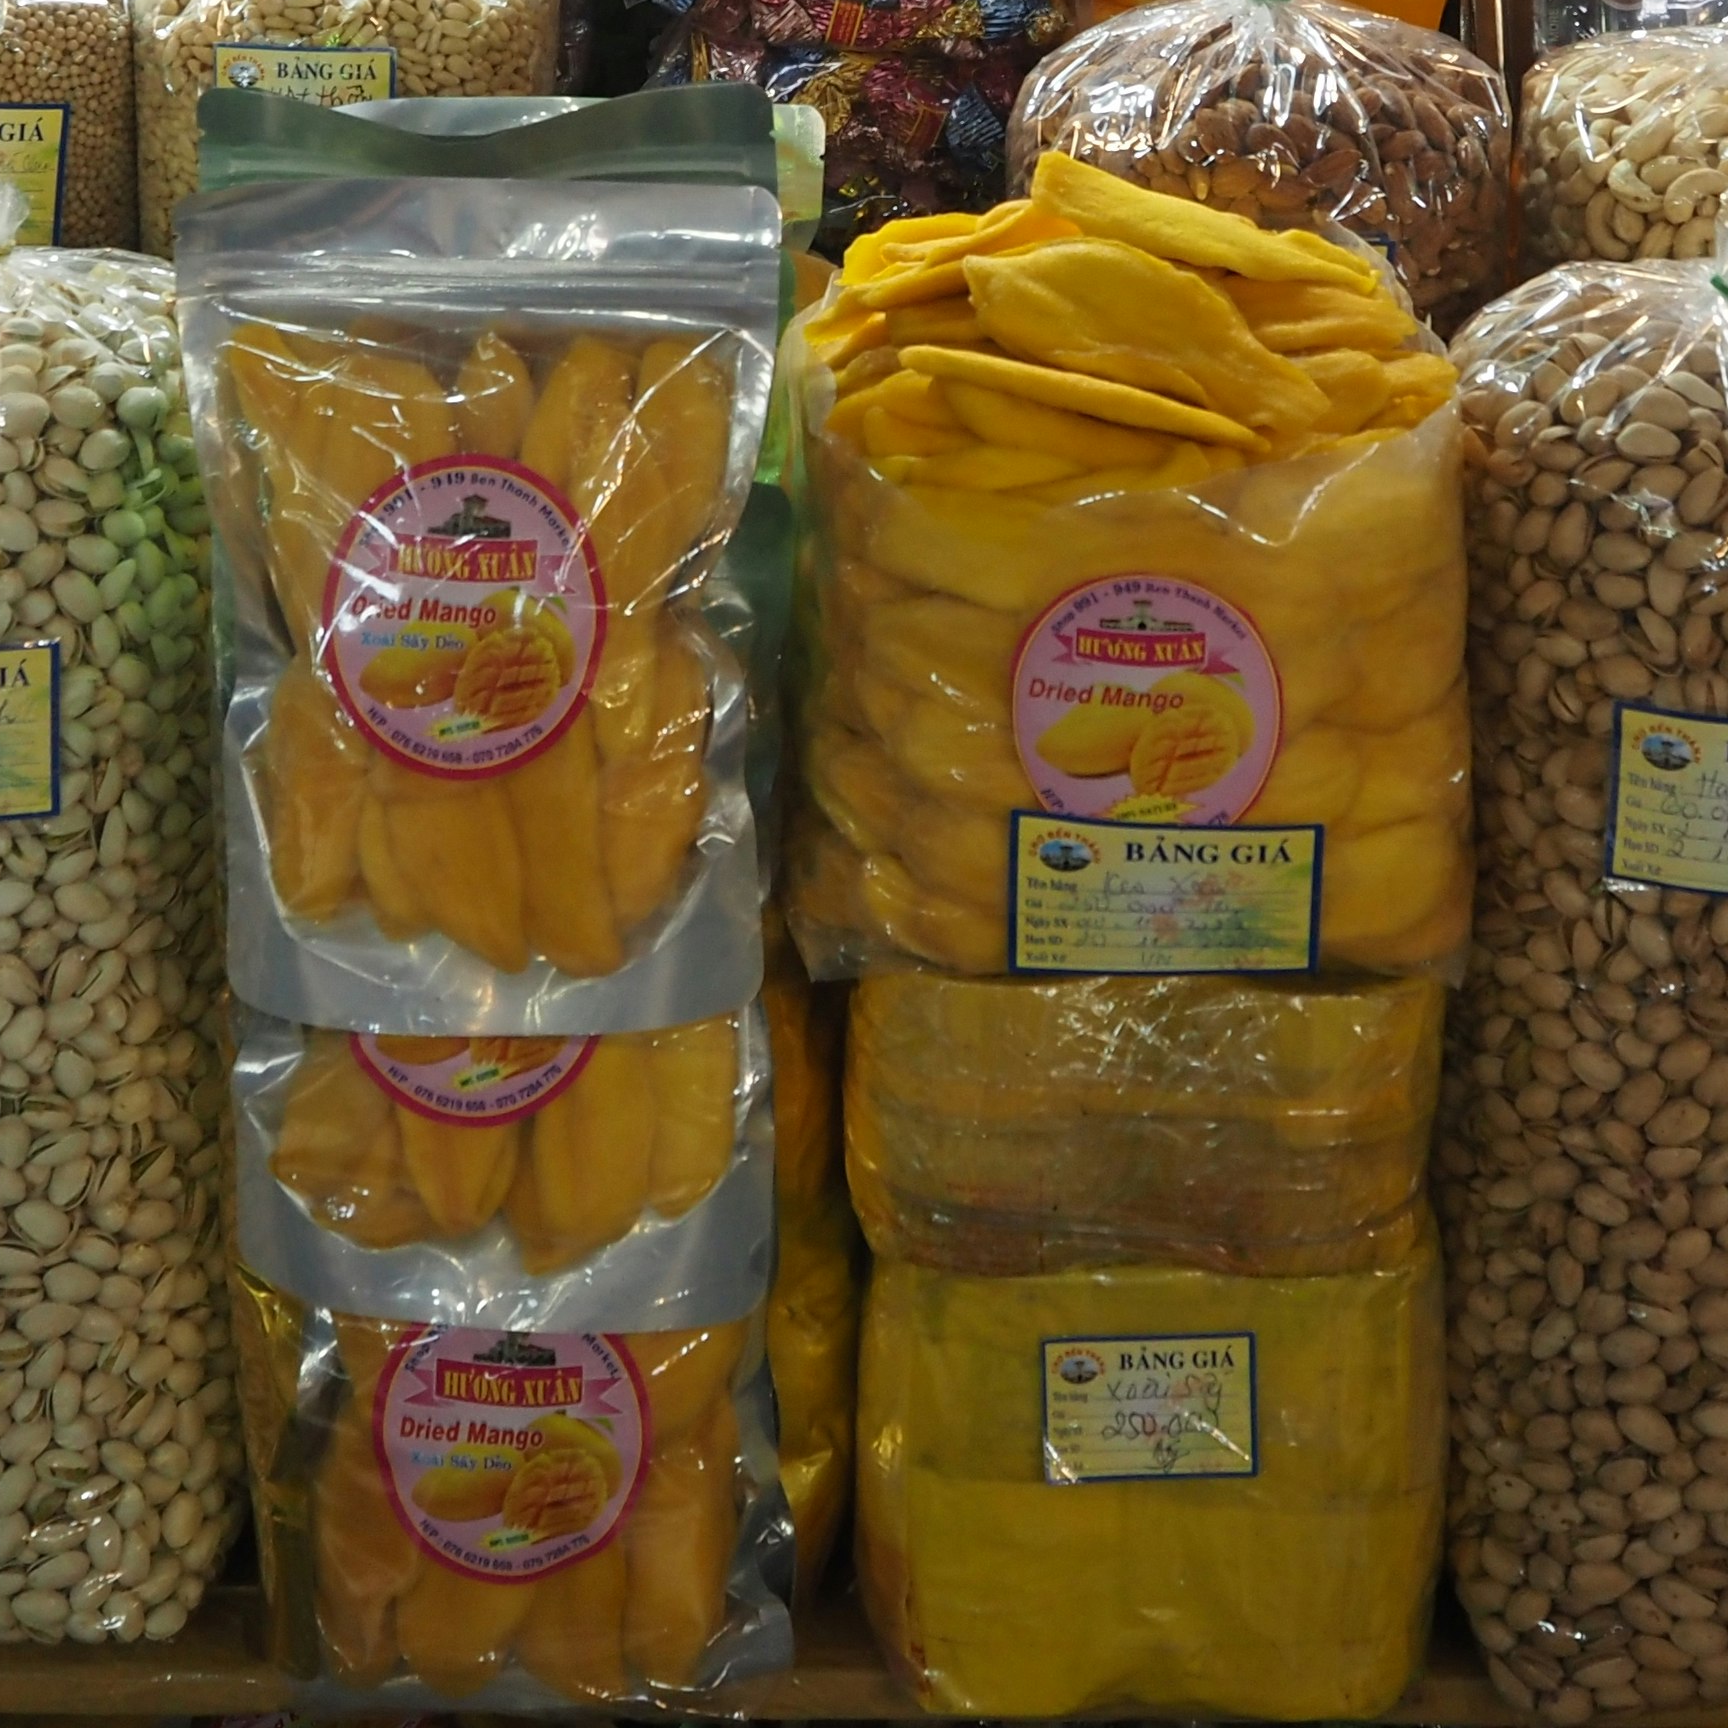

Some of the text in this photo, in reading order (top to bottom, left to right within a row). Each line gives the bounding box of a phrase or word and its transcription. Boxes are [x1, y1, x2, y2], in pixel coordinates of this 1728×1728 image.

[419, 599, 496, 629] Mango
[1078, 634, 1147, 661] HƯƠNG
[1029, 678, 1184, 715] Dried Mango
[1126, 835, 1291, 865] BẢNG GIÁ
[1119, 1344, 1235, 1371] BẢNG GIÁ
[399, 1416, 545, 1452] Dried Mango
